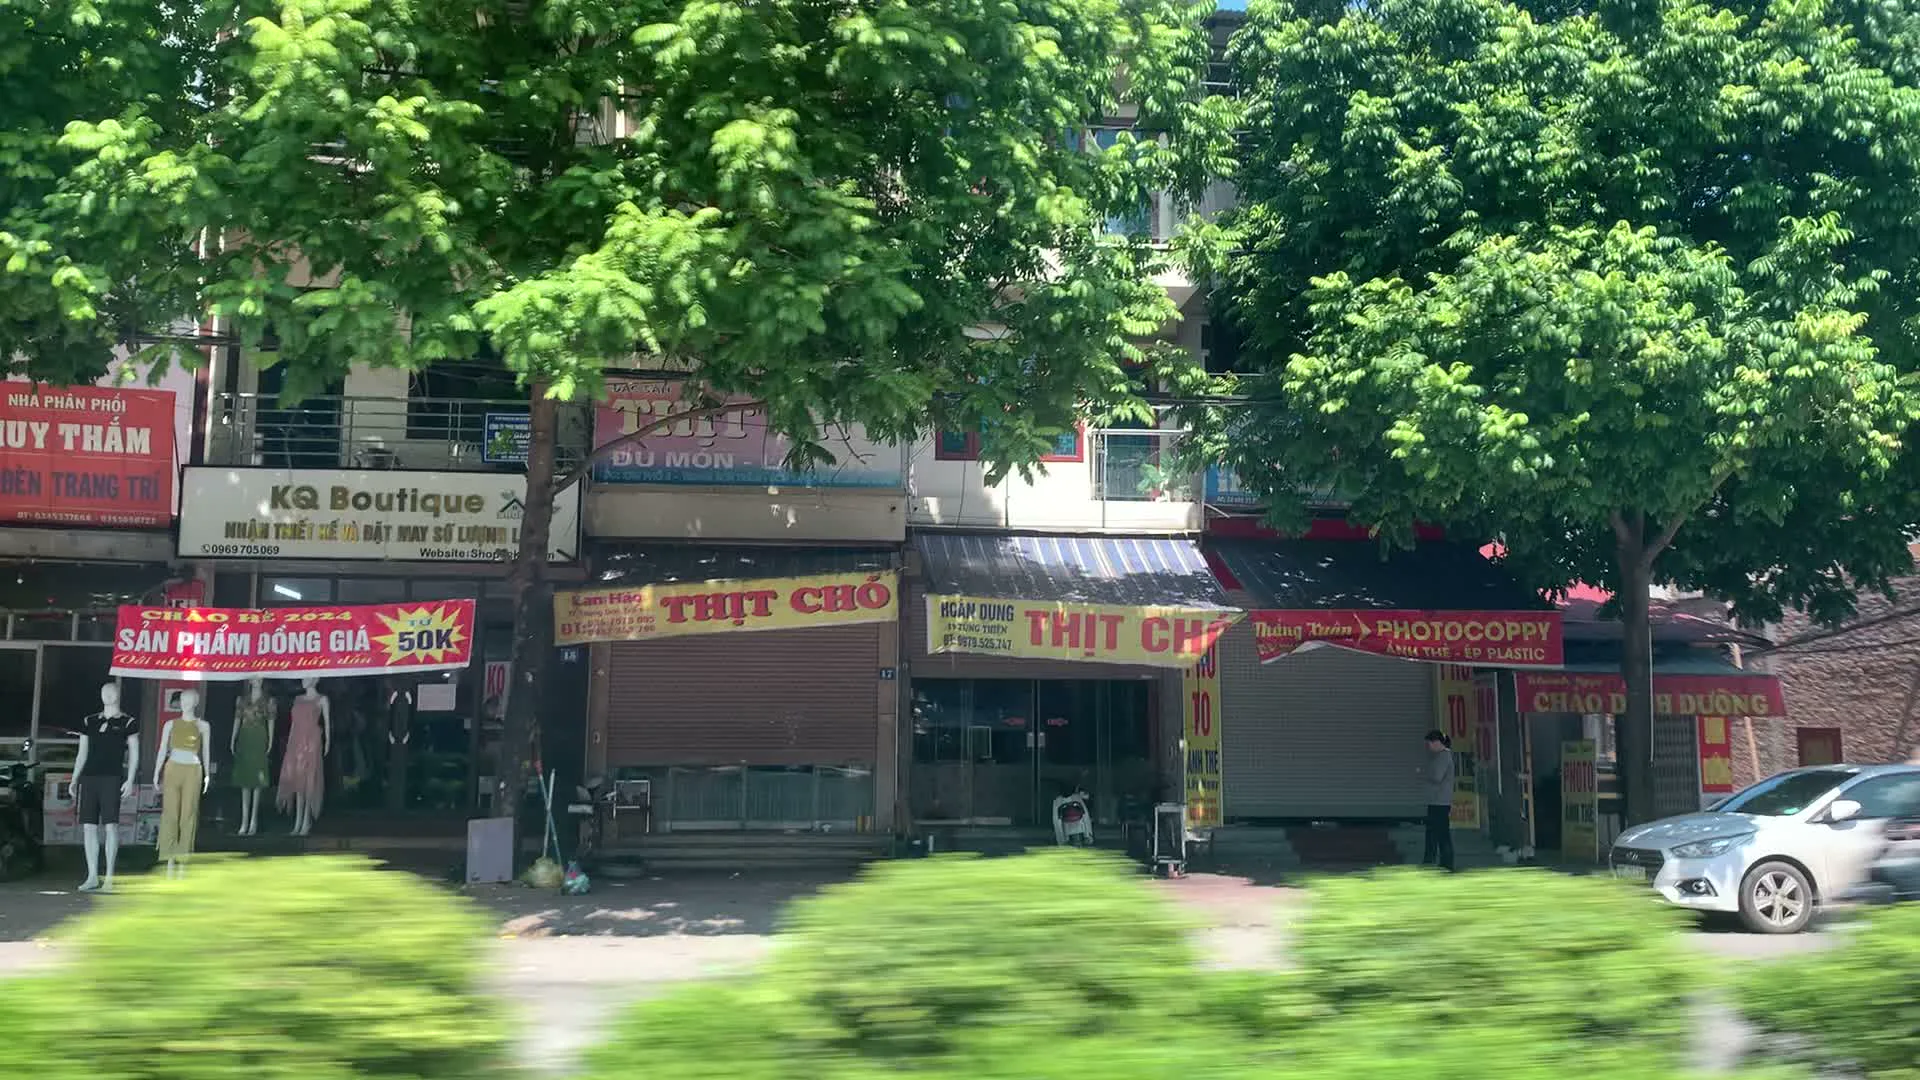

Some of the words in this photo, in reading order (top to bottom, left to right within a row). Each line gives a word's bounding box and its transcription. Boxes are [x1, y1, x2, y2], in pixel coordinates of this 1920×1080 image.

[44, 393, 86, 410] PHÂN
[91, 392, 127, 413] PHỐI
[52, 471, 120, 500] TRANG
[126, 471, 160, 502] TRÍ
[271, 485, 319, 512] KQ
[329, 485, 485, 519] Boutique
[225, 518, 269, 542] NHẬN
[274, 517, 313, 541] THIẾT
[341, 520, 359, 543] VÀ
[362, 521, 393, 544] ĐẶT
[397, 525, 429, 544] MAY
[432, 522, 456, 544] SỐ
[660, 590, 778, 626] THỊT
[791, 577, 891, 613] CHÓ
[140, 608, 229, 624] CHÀO
[239, 606, 276, 624] HÈ
[284, 609, 353, 623] 2024
[117, 621, 169, 654] SẢN
[176, 623, 250, 655] PHẨM
[257, 623, 321, 655] ĐỒNG
[329, 627, 370, 653] GIÁ
[398, 628, 454, 651] 50K
[1024, 610, 1125, 656] THỊT
[1376, 620, 1551, 641] PHOTOCOPPY
[1386, 641, 1419, 657] ẢNH
[1422, 642, 1450, 658] THẺ
[1465, 644, 1482, 659] ÉP
[1488, 648, 1545, 661] PLASTIC
[1610, 693, 1673, 714] DH
[1680, 688, 1768, 714] DƯỠNG
